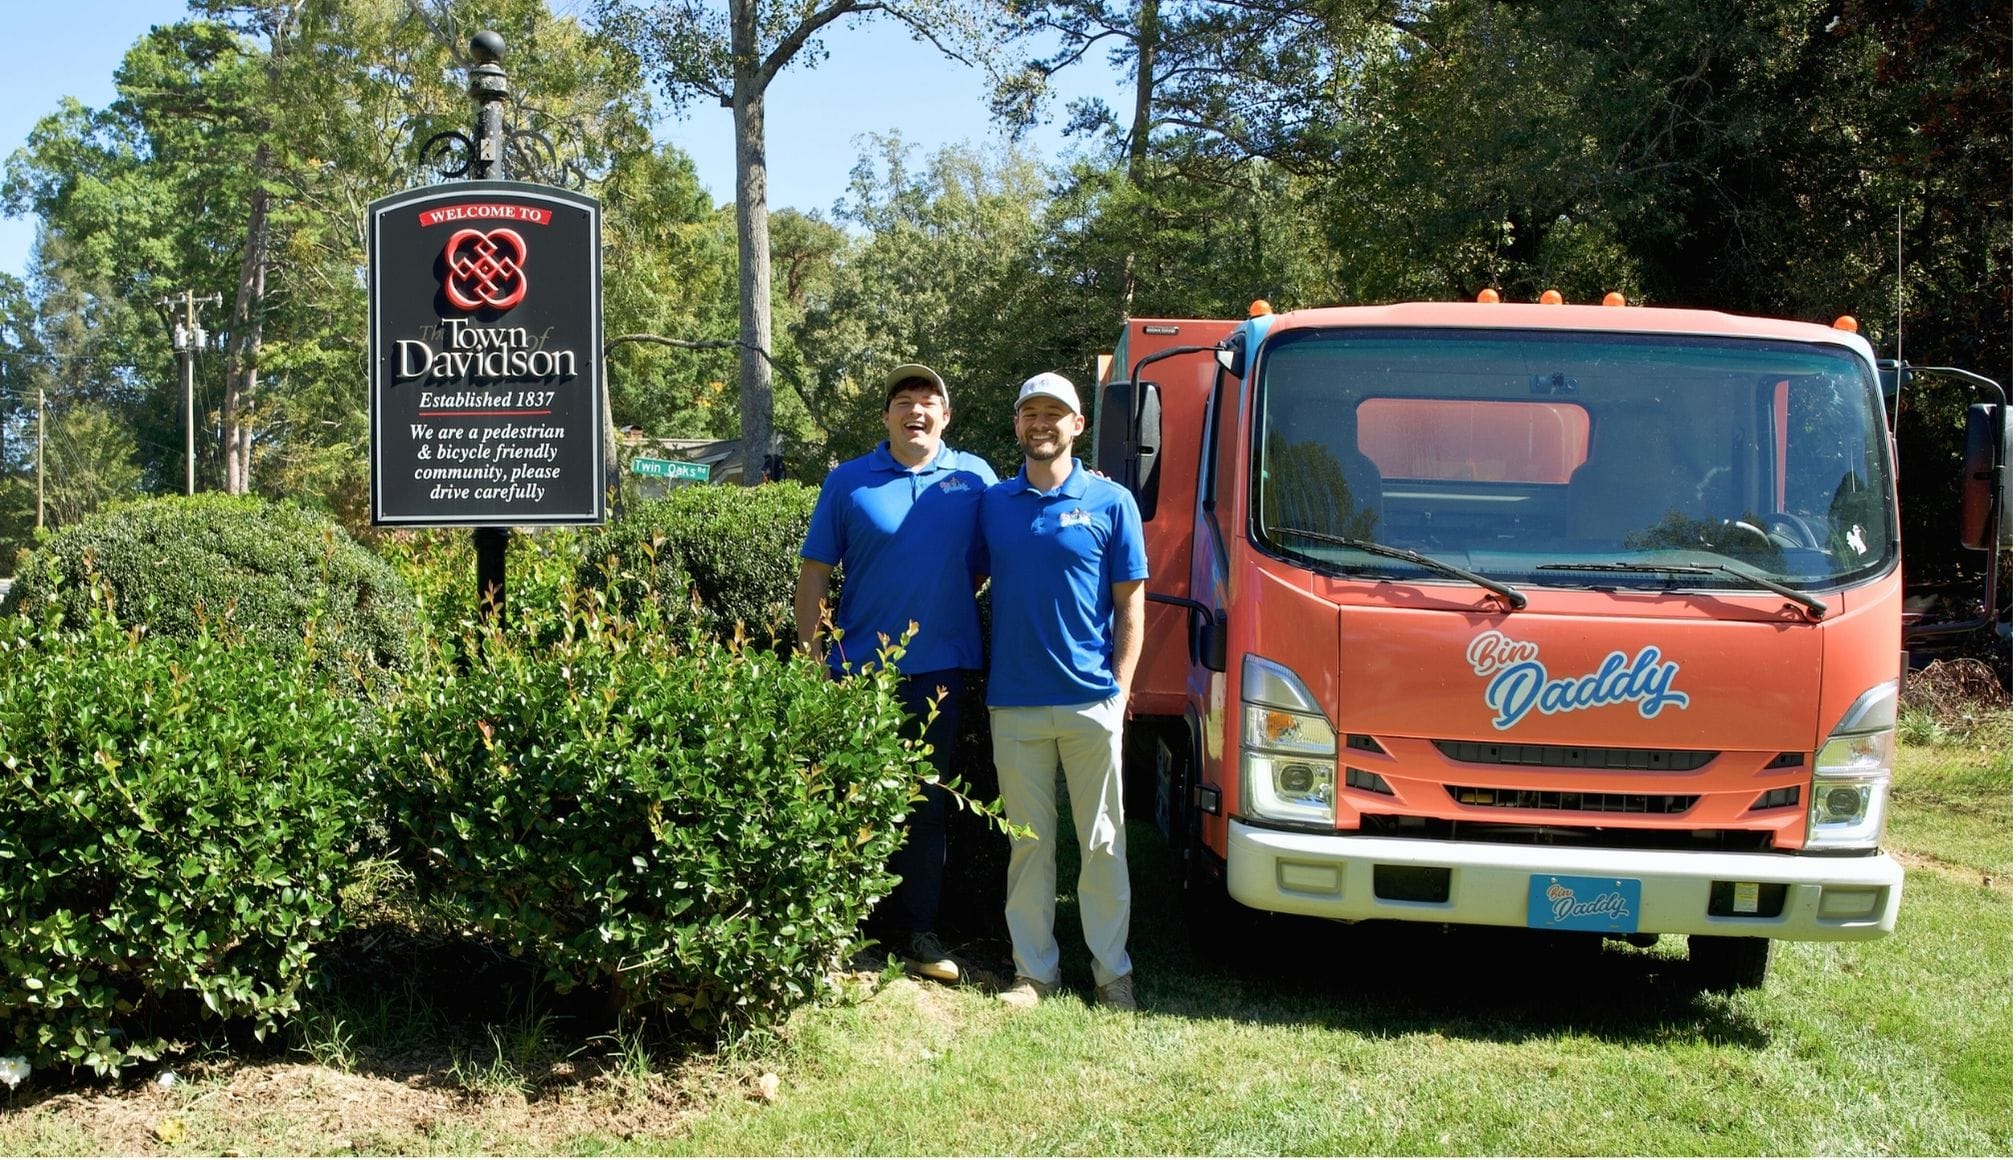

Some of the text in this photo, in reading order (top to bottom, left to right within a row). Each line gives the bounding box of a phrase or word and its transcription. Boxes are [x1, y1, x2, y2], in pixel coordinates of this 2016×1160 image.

[430, 206, 542, 223] WELCOME TO
[419, 325, 443, 341] Th
[441, 318, 528, 348] Town
[396, 341, 577, 378] Davidson
[419, 391, 555, 408] Established 1837
[410, 423, 565, 443] We are a pedestrian
[417, 443, 557, 463] & bicycle friendly
[414, 463, 560, 482] community, please
[635, 460, 661, 473] Twin
[668, 463, 696, 477] Oaks
[430, 483, 545, 502] drive carefully
[1467, 631, 1537, 675] Bin
[1486, 646, 1688, 729] Daddy
[1547, 884, 1573, 900] Bin
[1553, 892, 1629, 921] Daddy
